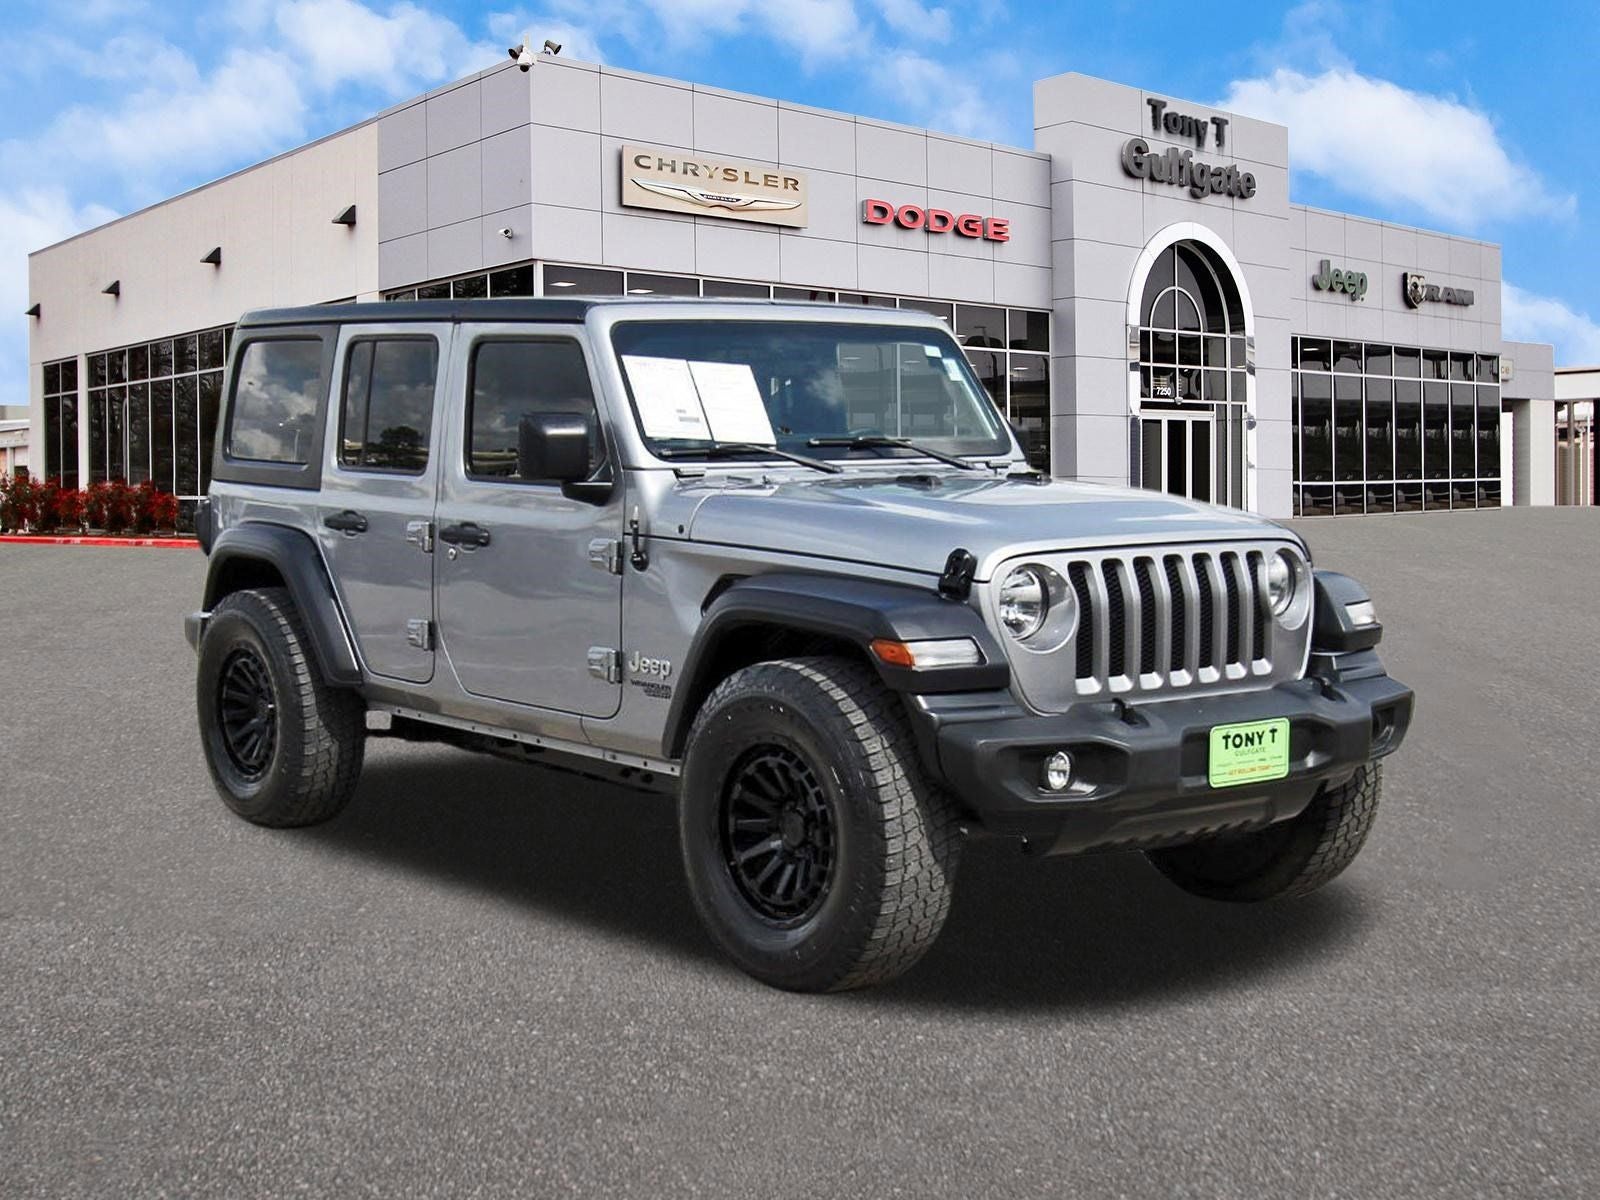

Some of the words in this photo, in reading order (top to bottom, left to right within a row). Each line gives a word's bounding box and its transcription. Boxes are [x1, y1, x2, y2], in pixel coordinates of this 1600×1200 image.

[1146, 97, 1208, 147] Tony
[1210, 116, 1229, 148] T
[633, 154, 800, 191] CHRYSLER
[1120, 137, 1257, 199] Gulfgate
[861, 197, 1011, 243] DODGE
[1311, 258, 1368, 302] Jeep
[1424, 283, 1475, 307] RAM
[1156, 386, 1172, 396] 7250
[628, 650, 671, 680] Jeep
[1222, 731, 1265, 749] TONY
[1269, 728, 1277, 743] T
